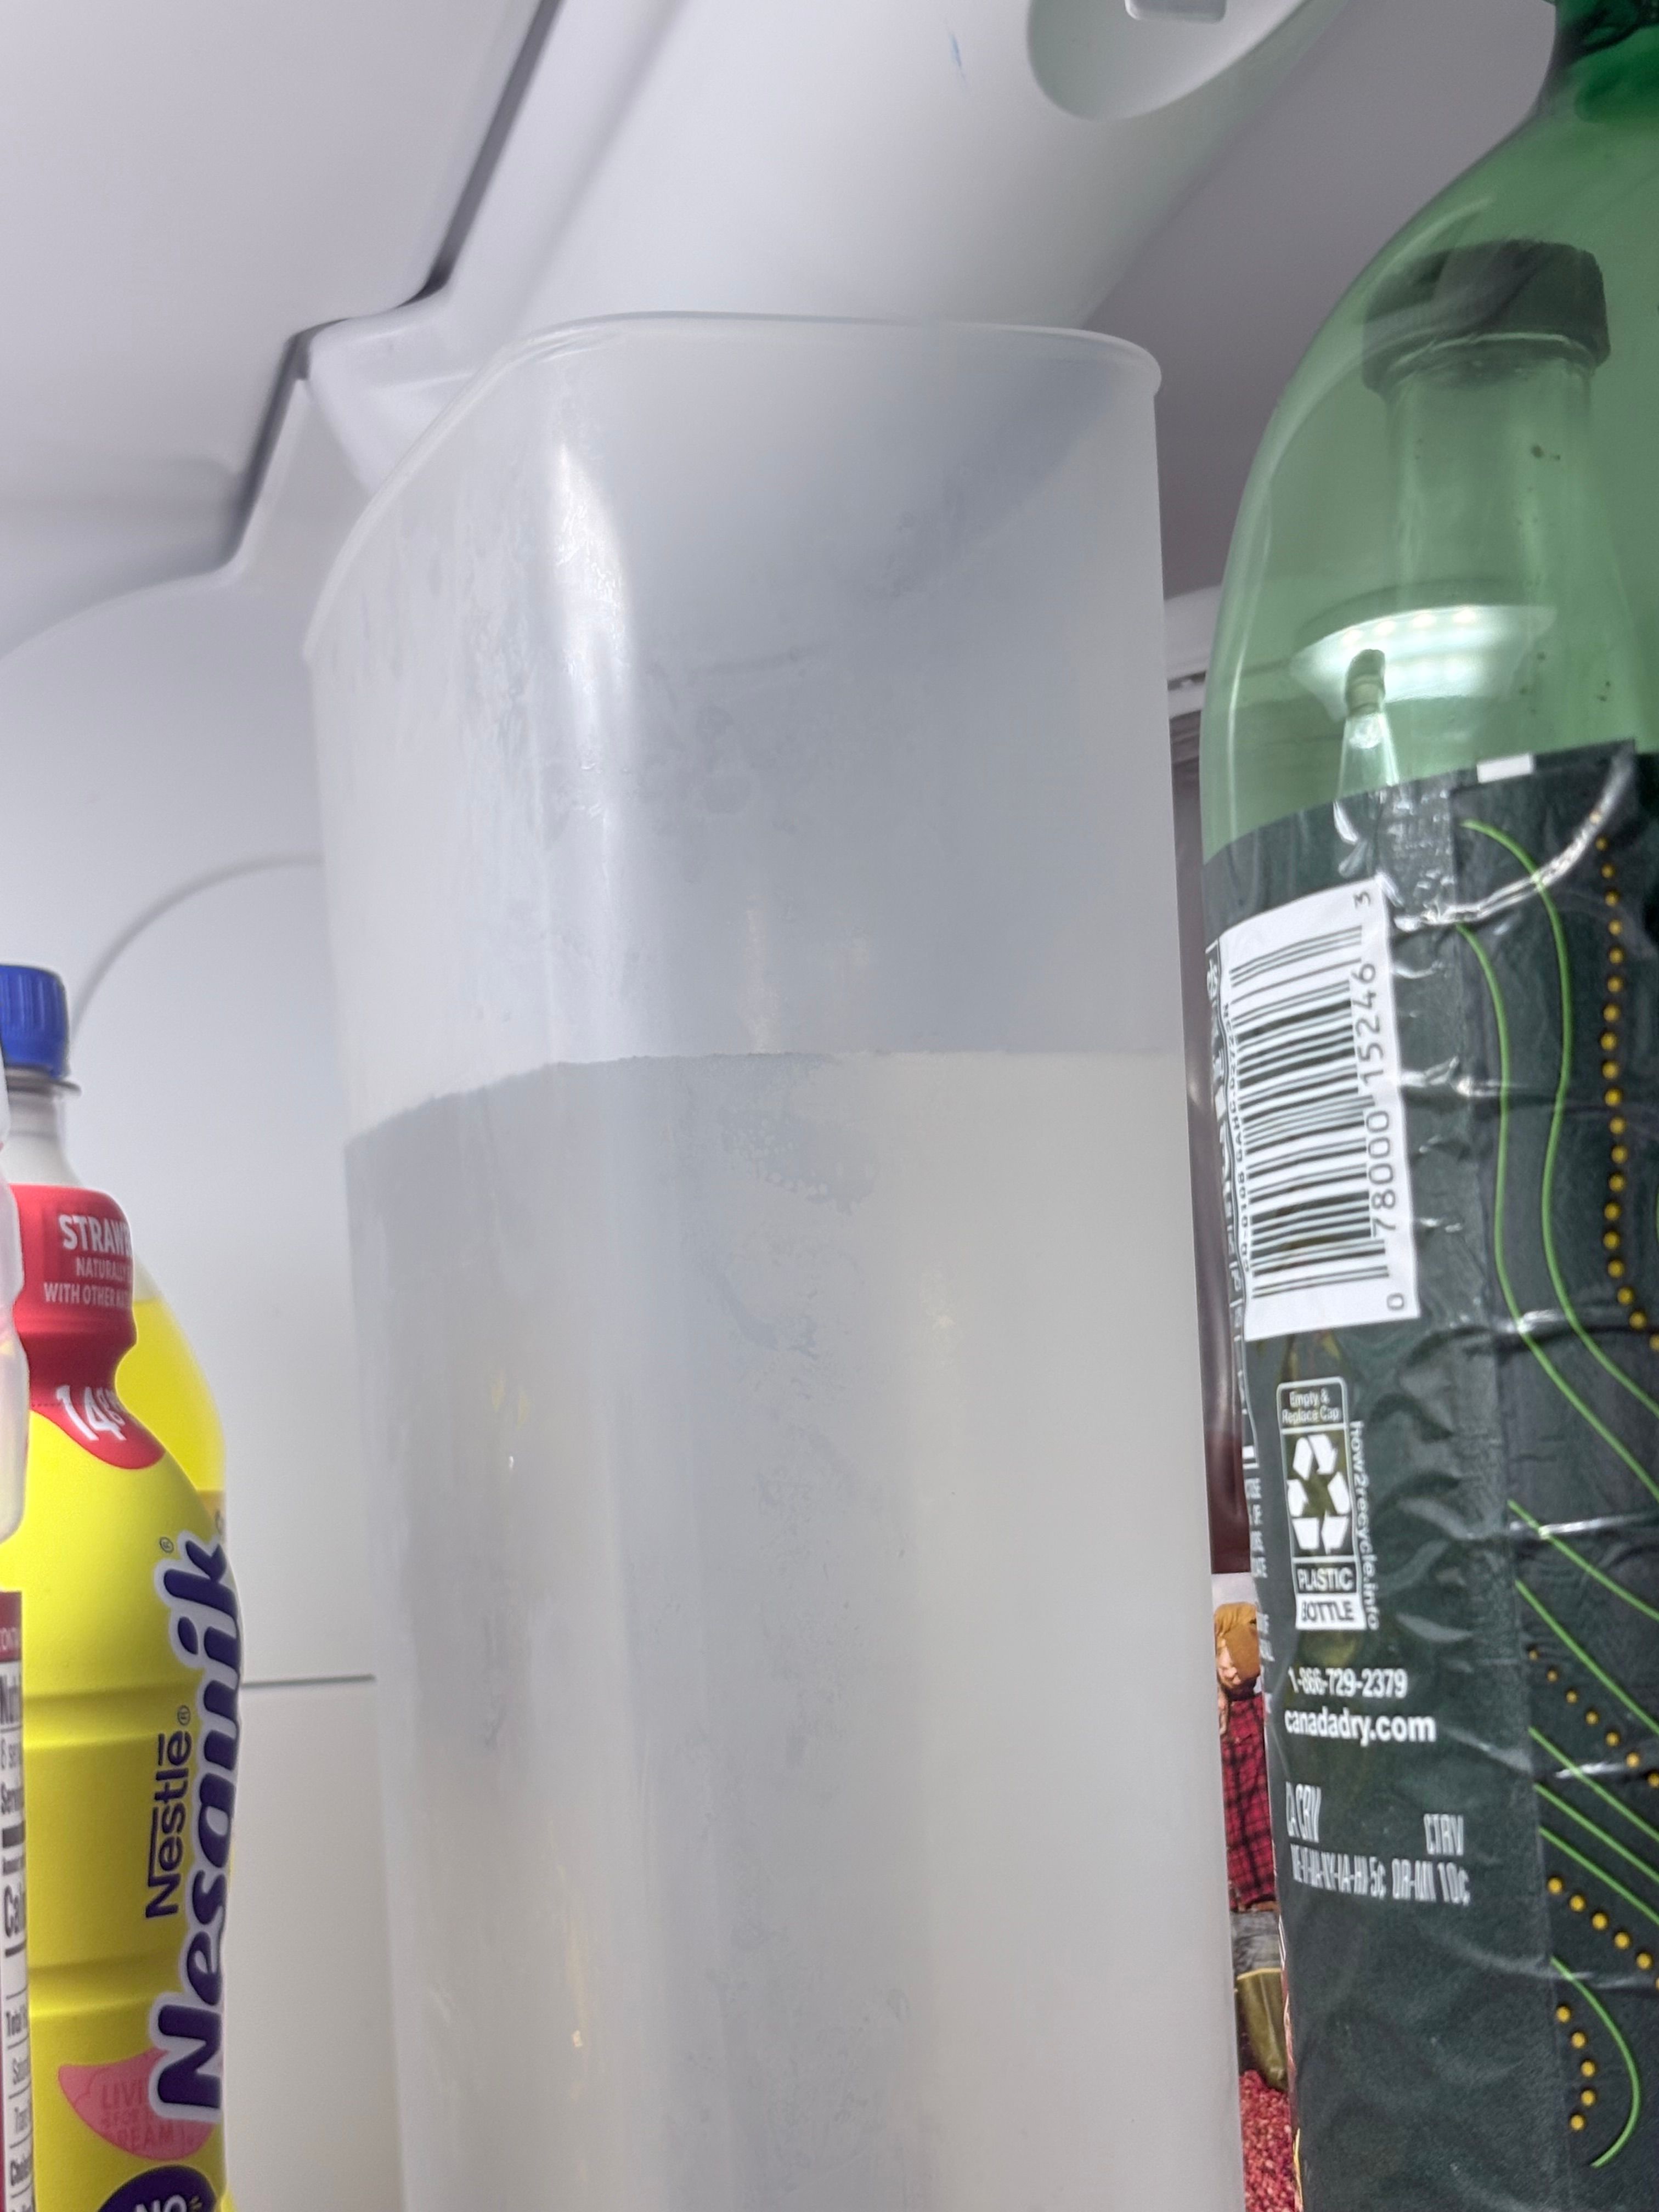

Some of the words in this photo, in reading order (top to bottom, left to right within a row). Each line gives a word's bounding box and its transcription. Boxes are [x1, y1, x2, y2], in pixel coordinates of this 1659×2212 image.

[1351, 964, 1384, 1084] 15246
[1365, 1109, 1397, 1238] 78000
[44, 1282, 80, 1304] WITH
[1282, 1408, 1319, 1426] Replace
[1320, 1404, 1341, 1423] Cap
[1350, 1420, 1380, 1630] how2recycle.info
[1297, 1567, 1354, 1592] PLASTIC
[1301, 1600, 1355, 1623] BOTTLE
[1284, 1706, 1437, 1747] canadadry.com
